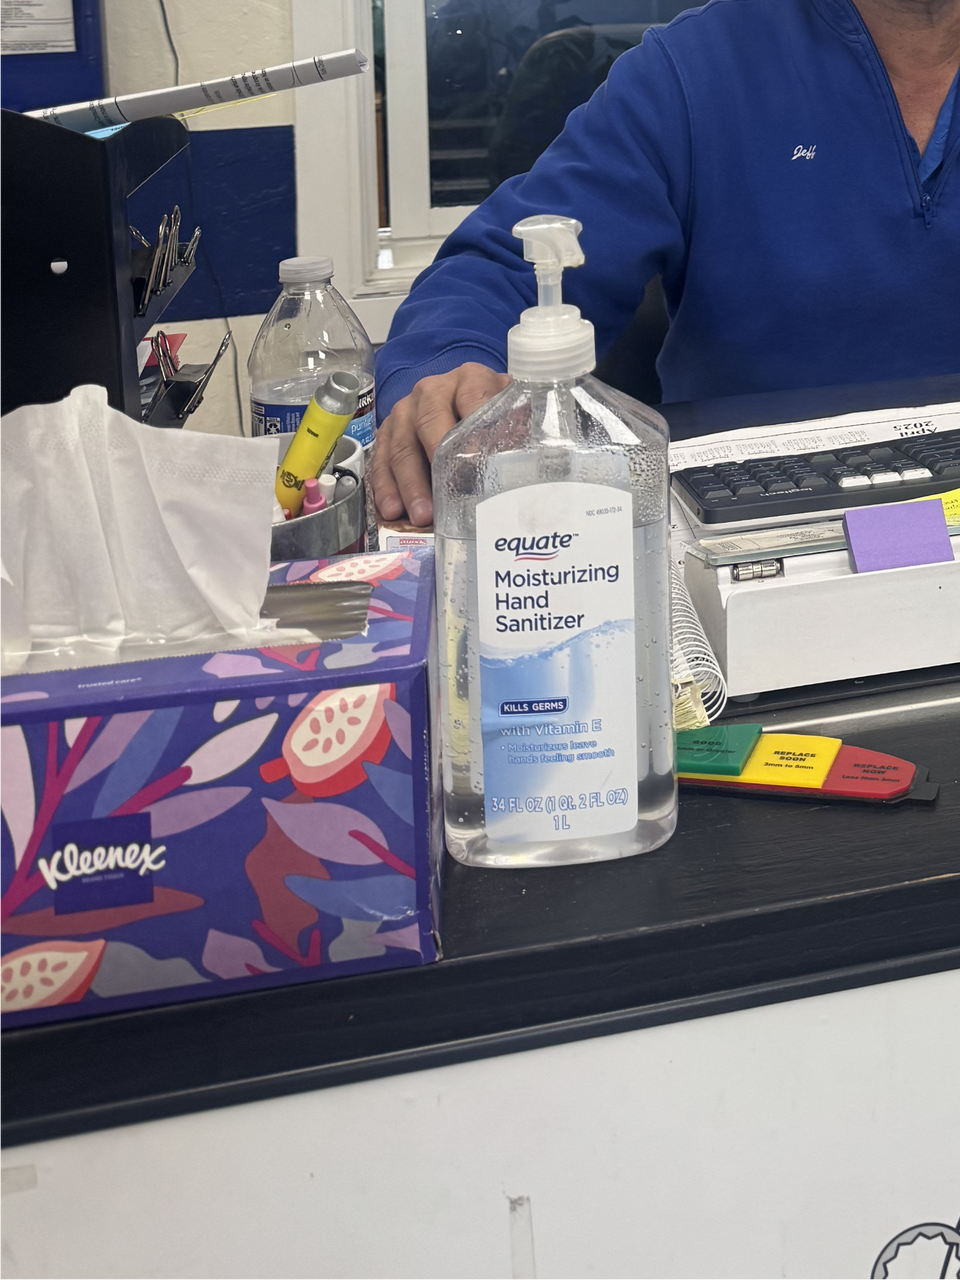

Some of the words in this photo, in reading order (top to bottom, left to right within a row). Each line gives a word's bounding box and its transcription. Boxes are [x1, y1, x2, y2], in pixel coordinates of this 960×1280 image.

[791, 144, 817, 161] Jeff
[893, 420, 934, 432] 2025
[899, 426, 938, 438] April
[760, 487, 813, 497] logitech
[494, 563, 619, 588] Moisturizing
[495, 590, 549, 610] Hand
[495, 612, 585, 633] Sanitizer
[503, 702, 529, 713] KILLS
[531, 700, 565, 712] GERMS
[500, 724, 531, 737] with
[535, 720, 588, 736] Vitamin
[591, 718, 602, 732] E
[508, 741, 568, 753] Moisturizers
[570, 740, 598, 750] leave
[773, 750, 817, 758] REPLACE
[508, 754, 539, 764] hands
[540, 752, 575, 764] feeling
[576, 748, 615, 761] smooth
[852, 762, 899, 771] REPLACE
[491, 797, 506, 812] 34
[508, 797, 524, 813] FL
[525, 796, 544, 813] OZ
[545, 796, 556, 814] (1
[558, 795, 577, 811] Qt.
[578, 794, 587, 809] 2
[588, 792, 604, 808] FL
[606, 788, 629, 805] OZ)
[553, 814, 560, 830] 1
[561, 814, 571, 830] L
[37, 842, 167, 891] Kleenex
